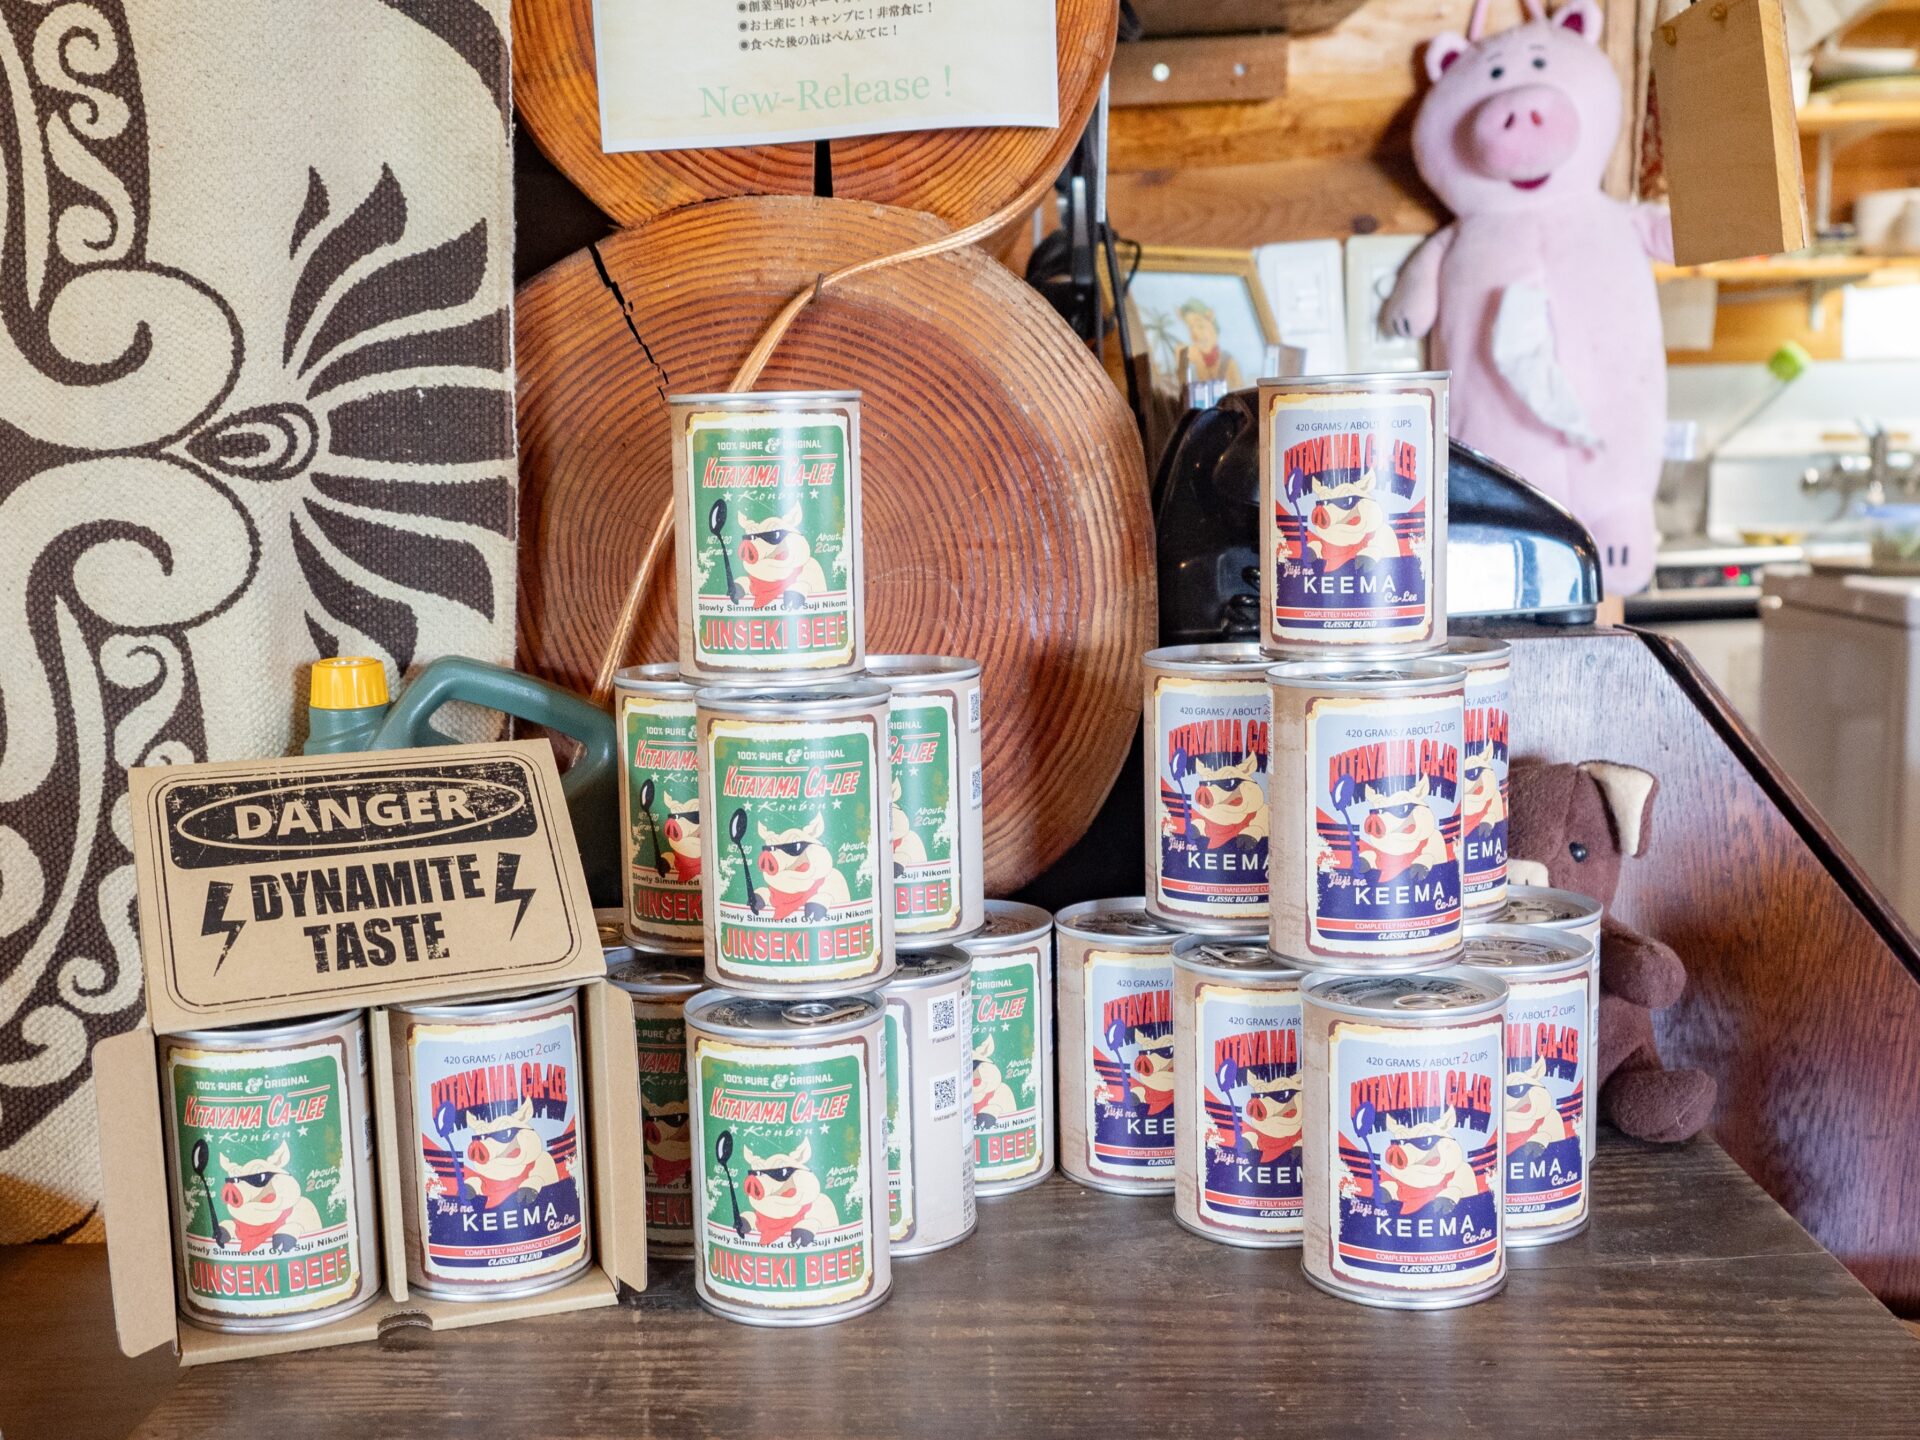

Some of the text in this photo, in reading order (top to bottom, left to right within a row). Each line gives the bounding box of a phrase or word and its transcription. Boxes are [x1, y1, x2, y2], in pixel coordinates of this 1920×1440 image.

[699, 73, 930, 119] New-Release
[1296, 423, 1310, 432] 420
[1311, 422, 1342, 432] GRAMS
[717, 441, 738, 451] 100%
[739, 441, 763, 451] PURE
[702, 456, 836, 488] KITAYAMA CA-LEE
[1283, 433, 1361, 487] KITAYAMA
[1303, 575, 1396, 595] KEEMA
[727, 604, 777, 612] Simmered
[702, 613, 845, 650] JINSEKI BEEF
[1323, 620, 1377, 629] CLASSIC BLEND
[1179, 706, 1262, 716] 420 GRAMS ABOUT
[646, 726, 687, 736] 100% PURE
[1168, 719, 1243, 763] KITAYAMA
[1345, 729, 1362, 738] 420
[1406, 725, 1434, 736] ABOUT
[1434, 721, 1441, 733] 2
[737, 751, 758, 761] 100%
[759, 751, 783, 761] PURE
[803, 749, 846, 760] ORIGINAL
[1329, 738, 1416, 793] KITAYAMA
[723, 766, 861, 799] KITAYAMA CA-LEE
[234, 788, 477, 840] DANGER
[249, 853, 486, 922] DYNAMITE
[896, 880, 948, 914] BEEF
[1355, 881, 1445, 905] KEEMA
[635, 889, 703, 921] JINSEK
[747, 914, 797, 924] Simmered
[825, 911, 843, 922] Suji
[303, 912, 451, 974] TASTE
[723, 922, 872, 962] JINSEKI BEEF
[1377, 930, 1408, 941] CLASSIC
[976, 978, 1013, 990] ORIGINAL
[1117, 979, 1164, 988] 420 GRAMS
[977, 995, 1026, 1022] CA-LEE
[1521, 1004, 1576, 1020] ABOUT 2 CUPS
[1228, 1017, 1279, 1027] 420 GRAMS
[444, 1041, 561, 1065] 420 GRAMS ABOUT 2 CUPS
[1215, 1029, 1297, 1074] KITAYAMA
[1366, 1051, 1488, 1067] 420 GRAMS ABOUT 2 CUPS
[195, 1080, 216, 1091] 100%
[218, 1081, 243, 1091] PURE
[264, 1074, 309, 1089] ORIGINAL
[431, 1063, 518, 1120] KITAYAMA
[723, 1074, 743, 1085] 100%
[745, 1077, 769, 1086] PURE
[790, 1073, 833, 1086] ORIGINAL
[710, 1087, 849, 1124] KITAYAMA CA-LEE
[1351, 1070, 1440, 1119] KITAYAMA
[184, 1094, 328, 1129] KITAYAMA CA-LEE
[988, 1126, 1035, 1163] BEEF
[1510, 1158, 1562, 1180] EMA
[463, 1202, 557, 1232] KEEMA
[1376, 1214, 1474, 1238] KEEMA
[213, 1247, 265, 1257] Simmered
[295, 1242, 314, 1252] Suji
[317, 1231, 349, 1247] Nikomi
[733, 1237, 784, 1249] Simmered
[812, 1237, 831, 1248] Suji
[833, 1229, 864, 1243] Nikomi
[192, 1246, 348, 1296] JINSEKI BEEF
[488, 1251, 542, 1267] CLASSIC BLEND
[710, 1243, 863, 1287] JINSEKI BEEF
[1400, 1263, 1456, 1273] CLASSIC BLEND
